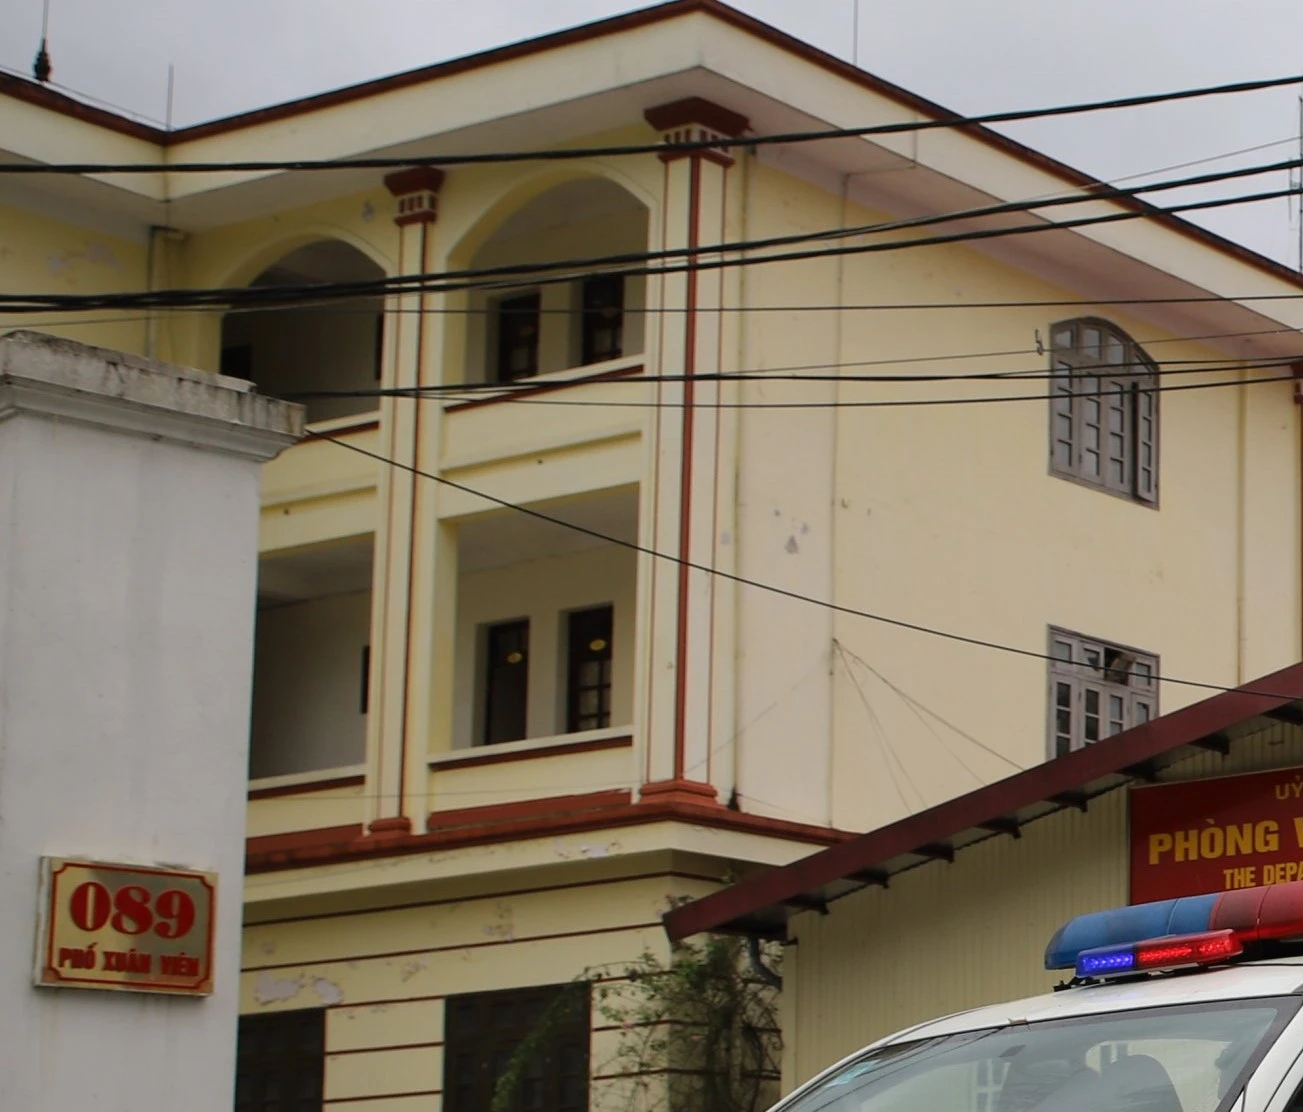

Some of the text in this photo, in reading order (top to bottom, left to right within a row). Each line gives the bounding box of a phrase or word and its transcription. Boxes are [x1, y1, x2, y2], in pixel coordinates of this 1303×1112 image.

[1275, 778, 1303, 800] UỶ
[1149, 818, 1279, 865] PHÒNG
[1223, 866, 1256, 890] THE
[70, 881, 196, 940] 089
